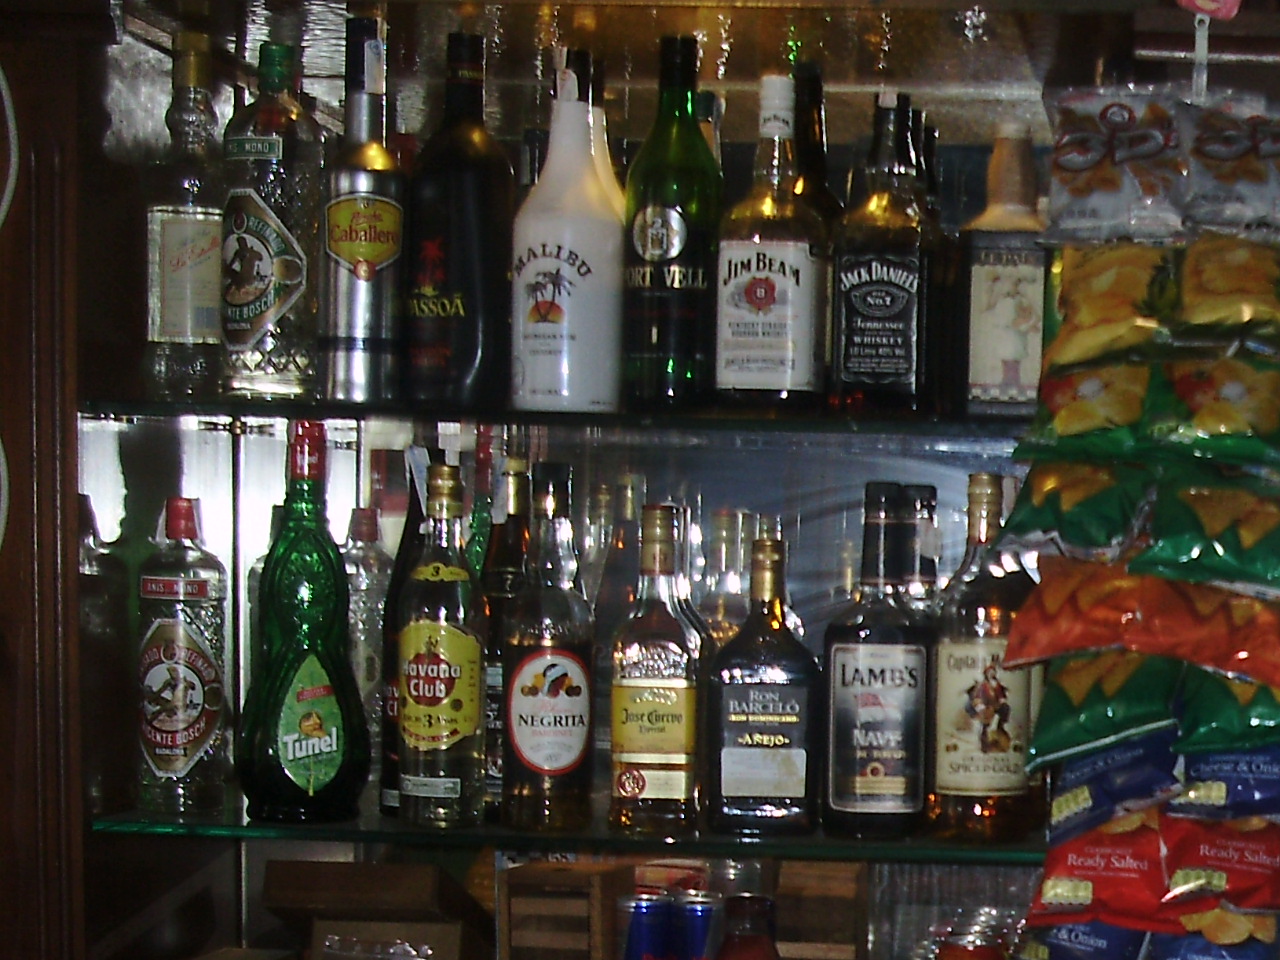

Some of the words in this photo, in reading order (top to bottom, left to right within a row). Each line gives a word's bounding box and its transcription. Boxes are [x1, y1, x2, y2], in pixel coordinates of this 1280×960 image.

[513, 241, 593, 282] MALIBU
[723, 258, 751, 287] JIM
[756, 252, 800, 287] BEAM
[839, 267, 871, 292] JACK
[841, 663, 918, 689] LAMB'S
[409, 679, 448, 698] Club
[518, 714, 587, 728] NEGRITA
[282, 726, 339, 761] Tunel
[1067, 853, 1107, 870] Ready
[1110, 856, 1148, 871] Salted
[1199, 844, 1241, 863] Ready
[1244, 848, 1280, 868] Salted
[1070, 928, 1108, 948] Onion
